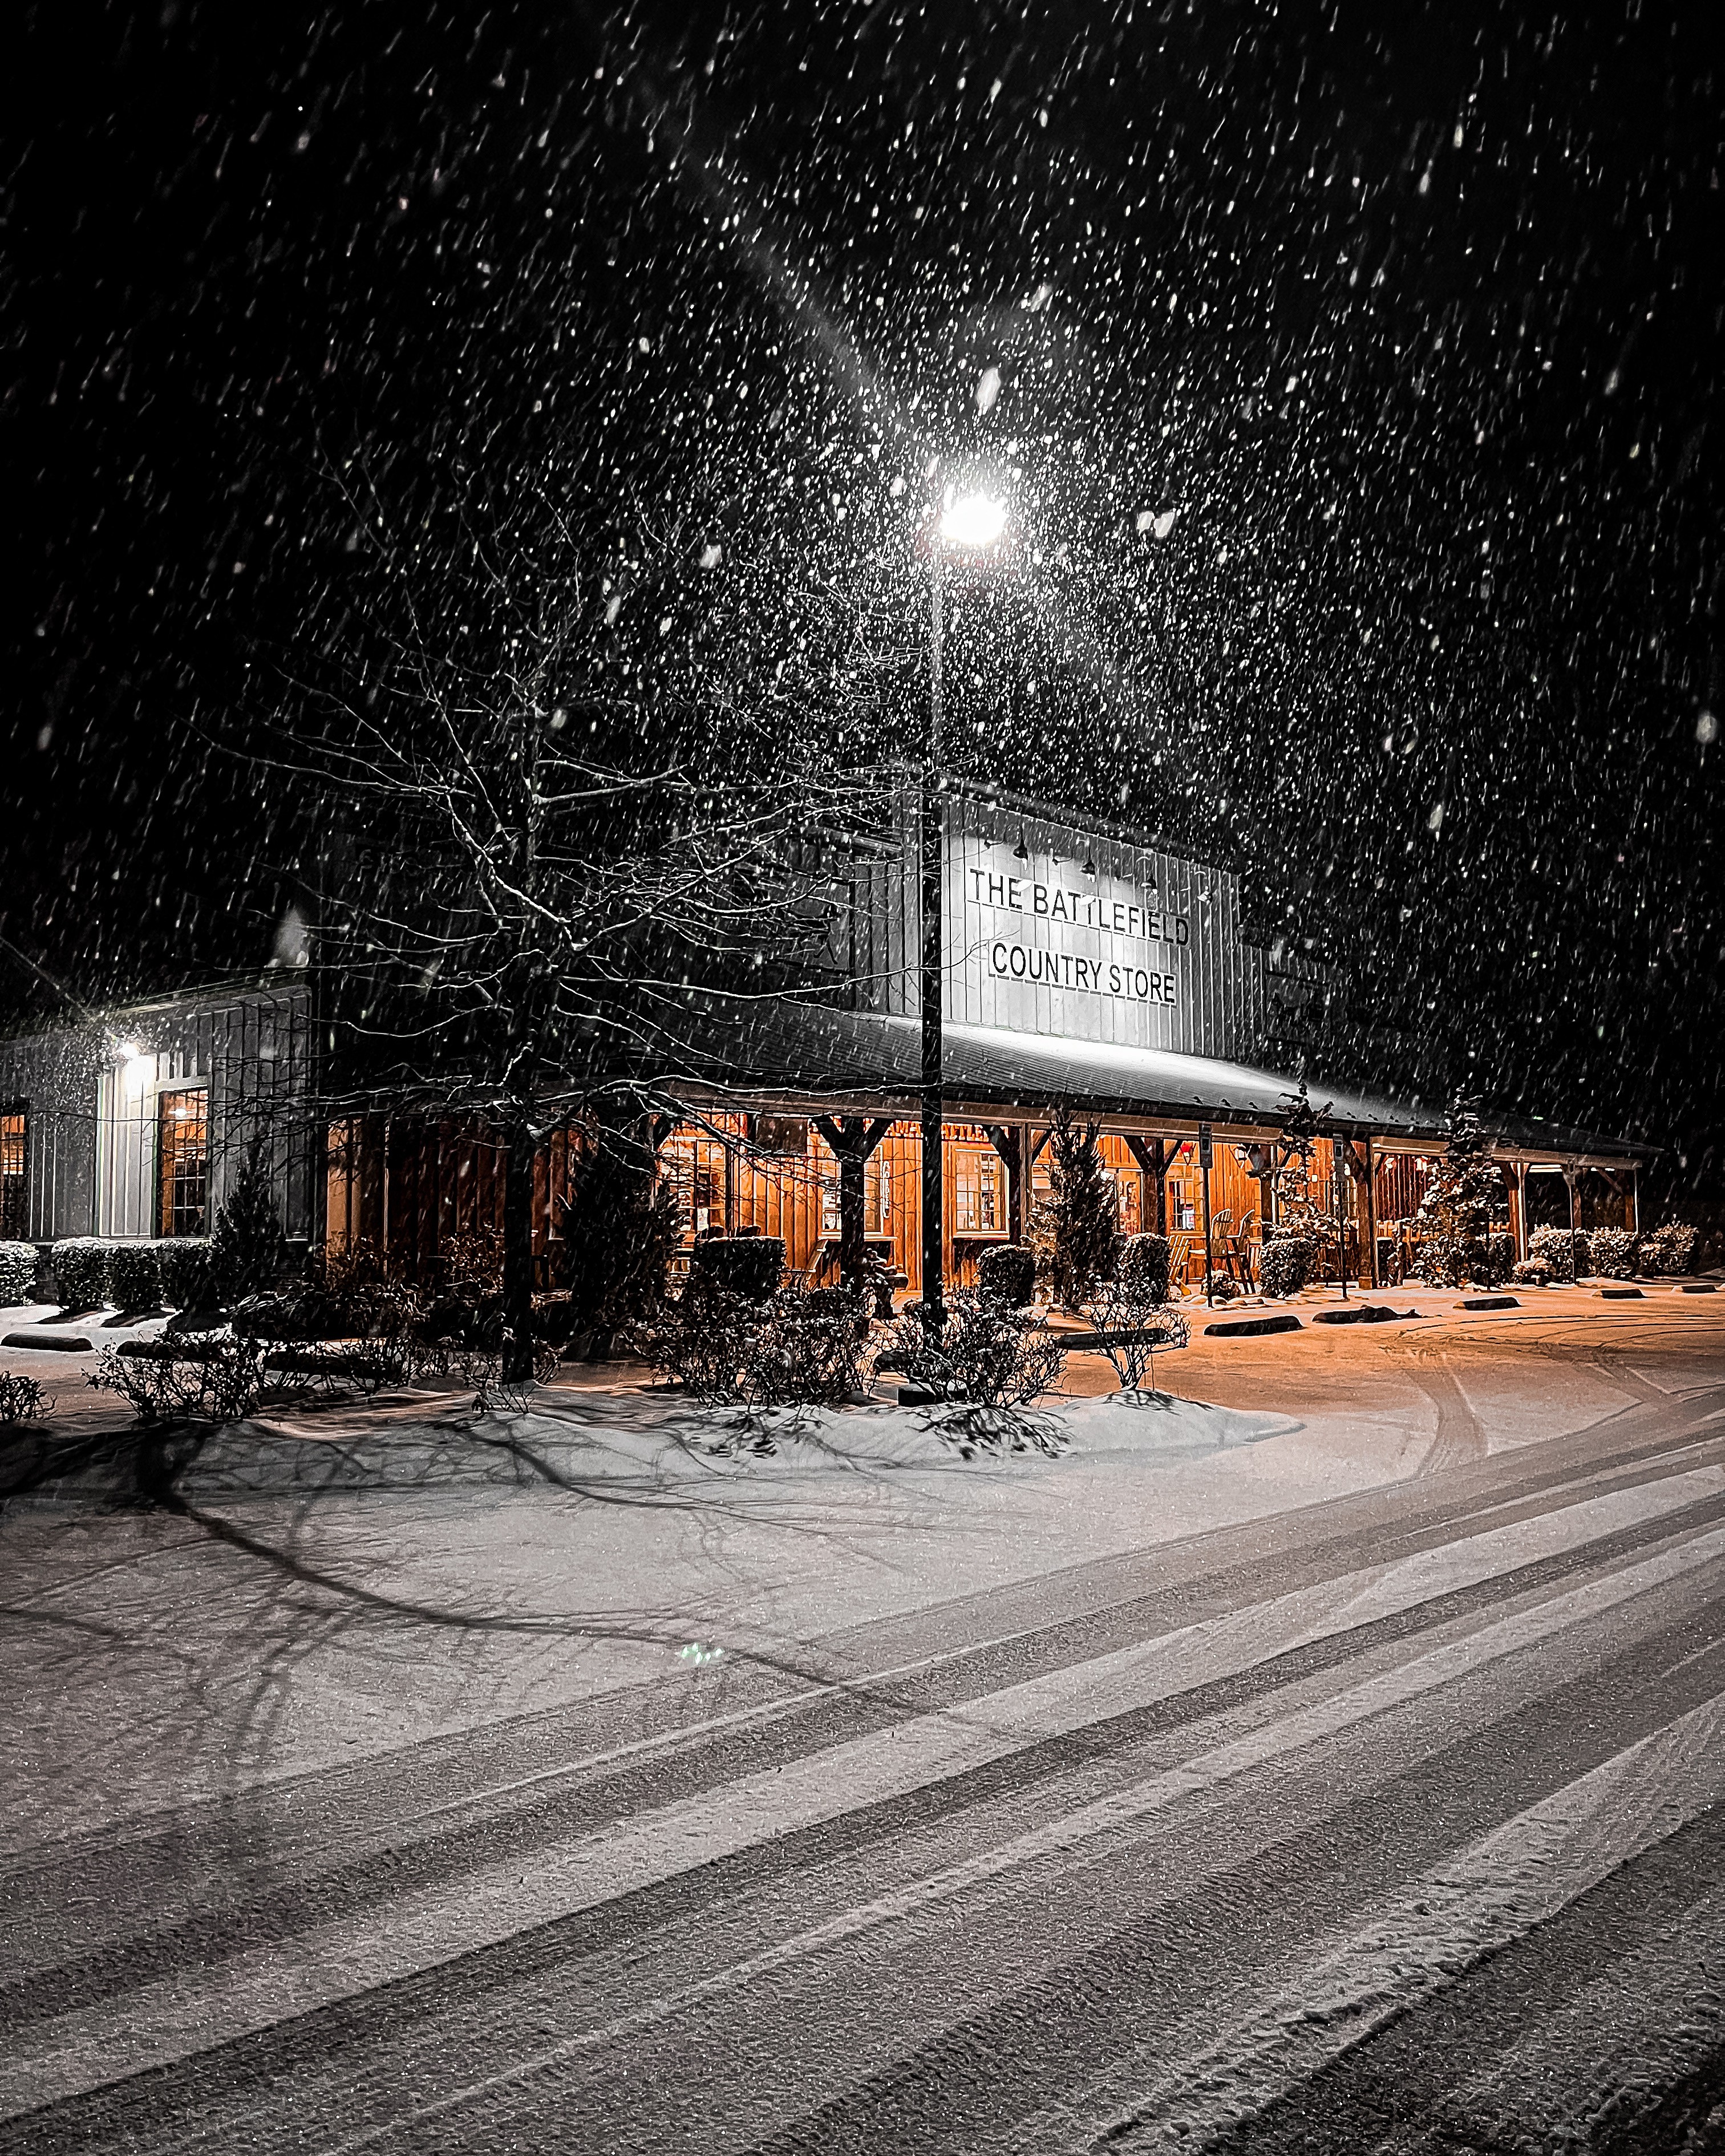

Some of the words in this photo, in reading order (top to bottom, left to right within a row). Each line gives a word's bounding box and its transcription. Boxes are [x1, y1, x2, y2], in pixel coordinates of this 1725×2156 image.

[970, 868, 1023, 910] THE
[1034, 883, 1189, 946] BATTLEFIELD
[993, 942, 1103, 990] COUNTRY
[1109, 964, 1175, 1003] STORE
